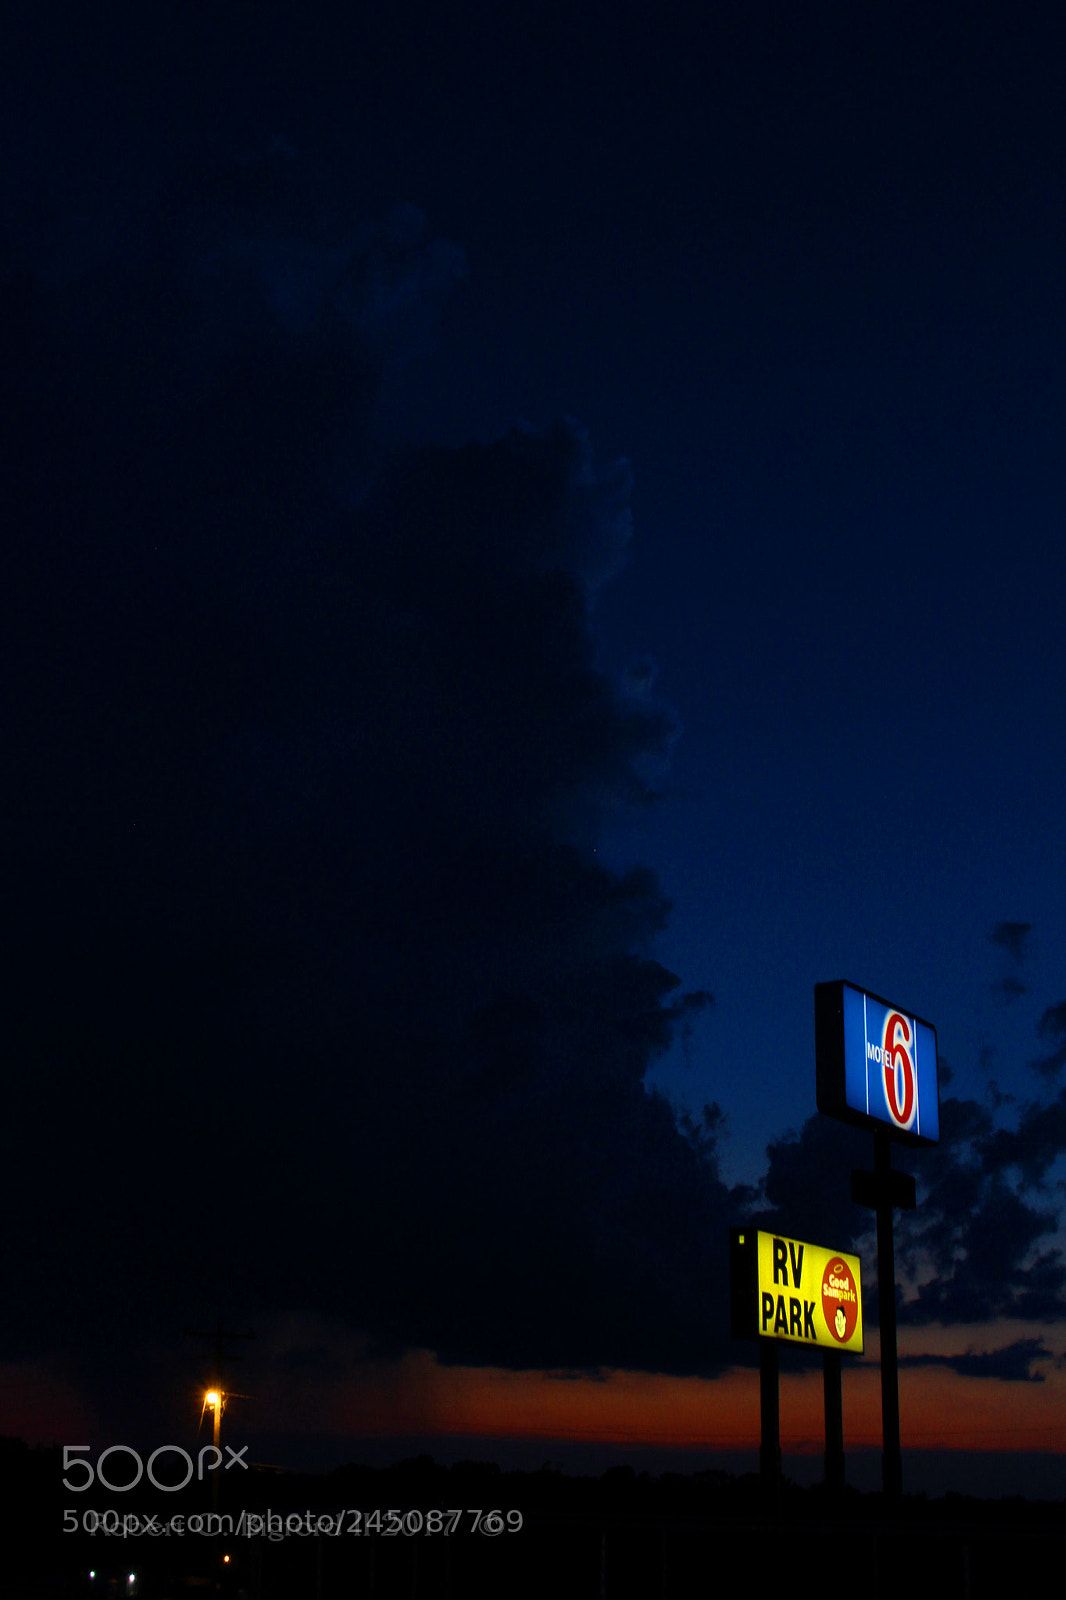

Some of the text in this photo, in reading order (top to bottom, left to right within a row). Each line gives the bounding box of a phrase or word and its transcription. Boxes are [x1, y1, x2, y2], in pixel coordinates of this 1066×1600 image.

[867, 1010, 916, 1130] MOTEL 6
[773, 1237, 804, 1289] RV
[829, 1274, 849, 1291] Good
[762, 1291, 817, 1340] PARK
